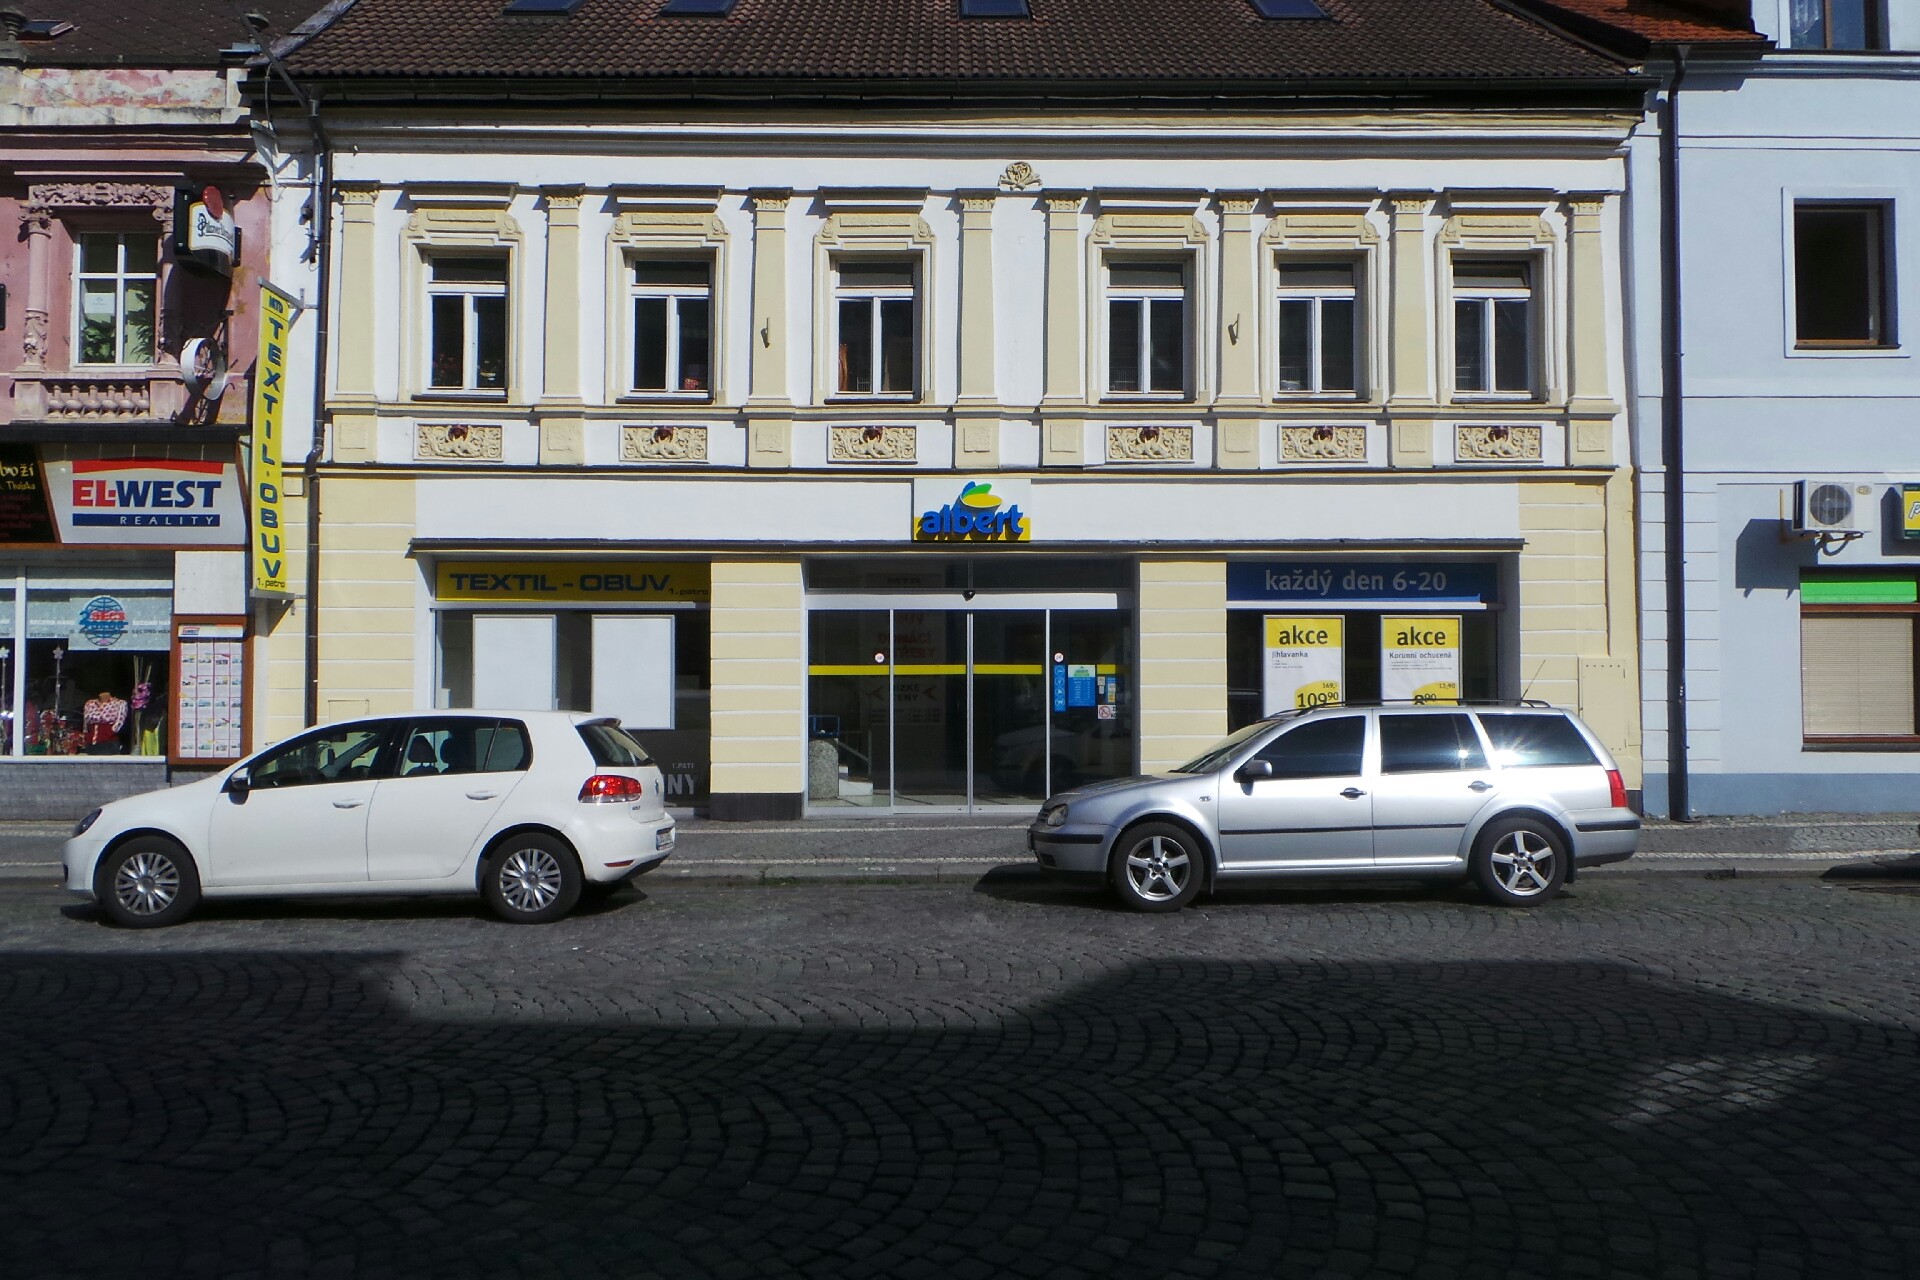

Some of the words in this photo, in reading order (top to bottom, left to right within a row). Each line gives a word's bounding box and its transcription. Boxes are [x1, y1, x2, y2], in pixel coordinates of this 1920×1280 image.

[262, 316, 283, 466] TEXTIL
[73, 480, 222, 508] EL-WEST
[119, 516, 214, 525] REALITY
[260, 482, 282, 578] OBUV
[921, 504, 1024, 534] albert
[449, 573, 558, 591] TEXTIL
[579, 574, 671, 591] OBUV
[1265, 569, 1333, 596] každý
[1342, 570, 1384, 591] den
[1392, 571, 1447, 591] 6-20
[1279, 625, 1329, 645] akce
[1397, 626, 1447, 646] akce
